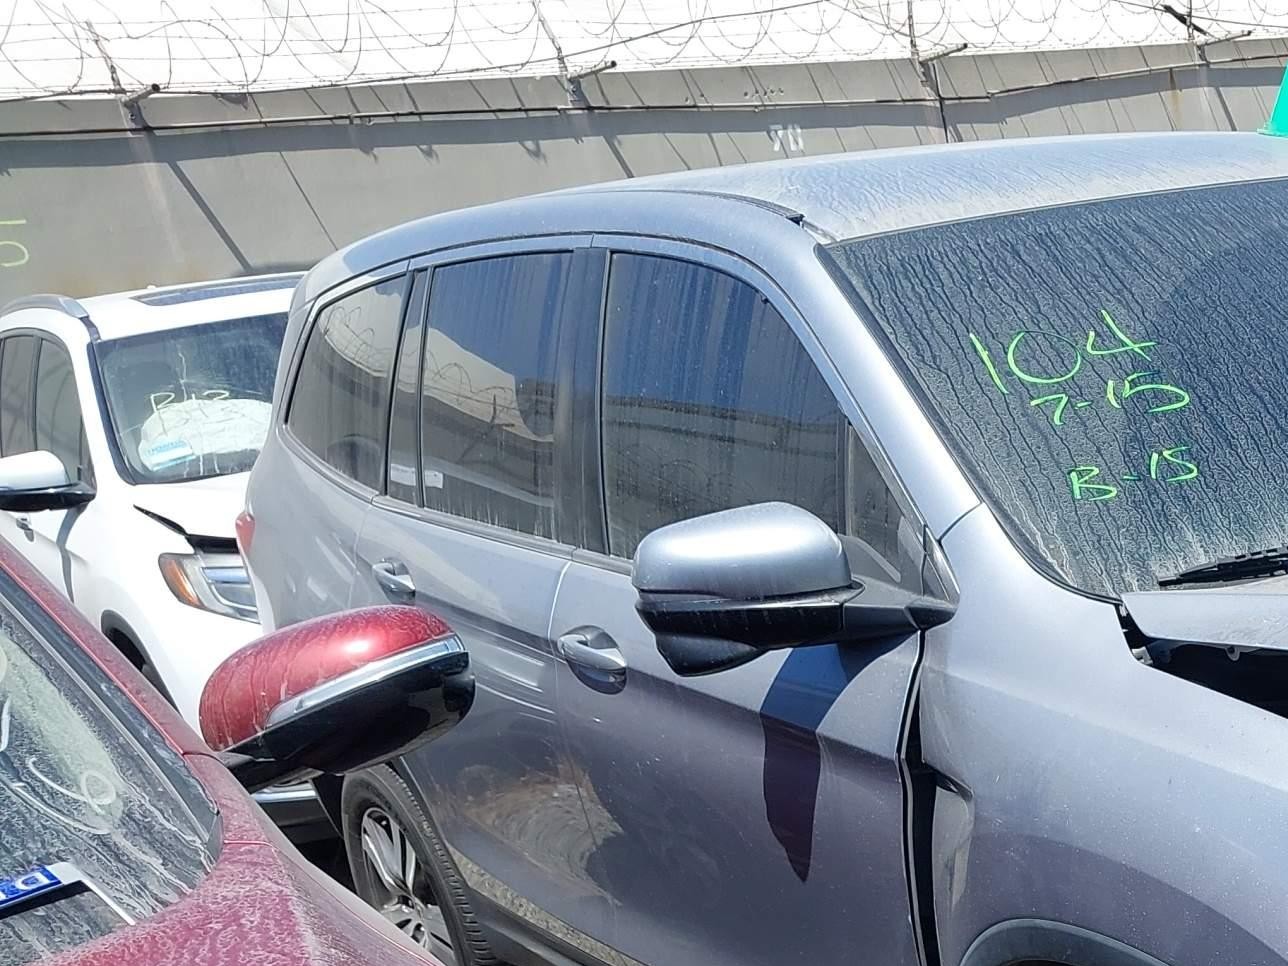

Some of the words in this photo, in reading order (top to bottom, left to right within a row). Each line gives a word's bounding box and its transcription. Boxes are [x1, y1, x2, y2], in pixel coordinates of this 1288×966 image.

[969, 309, 1159, 394] 104
[1030, 371, 1191, 426] 7-15
[1068, 446, 1199, 502] B-15
